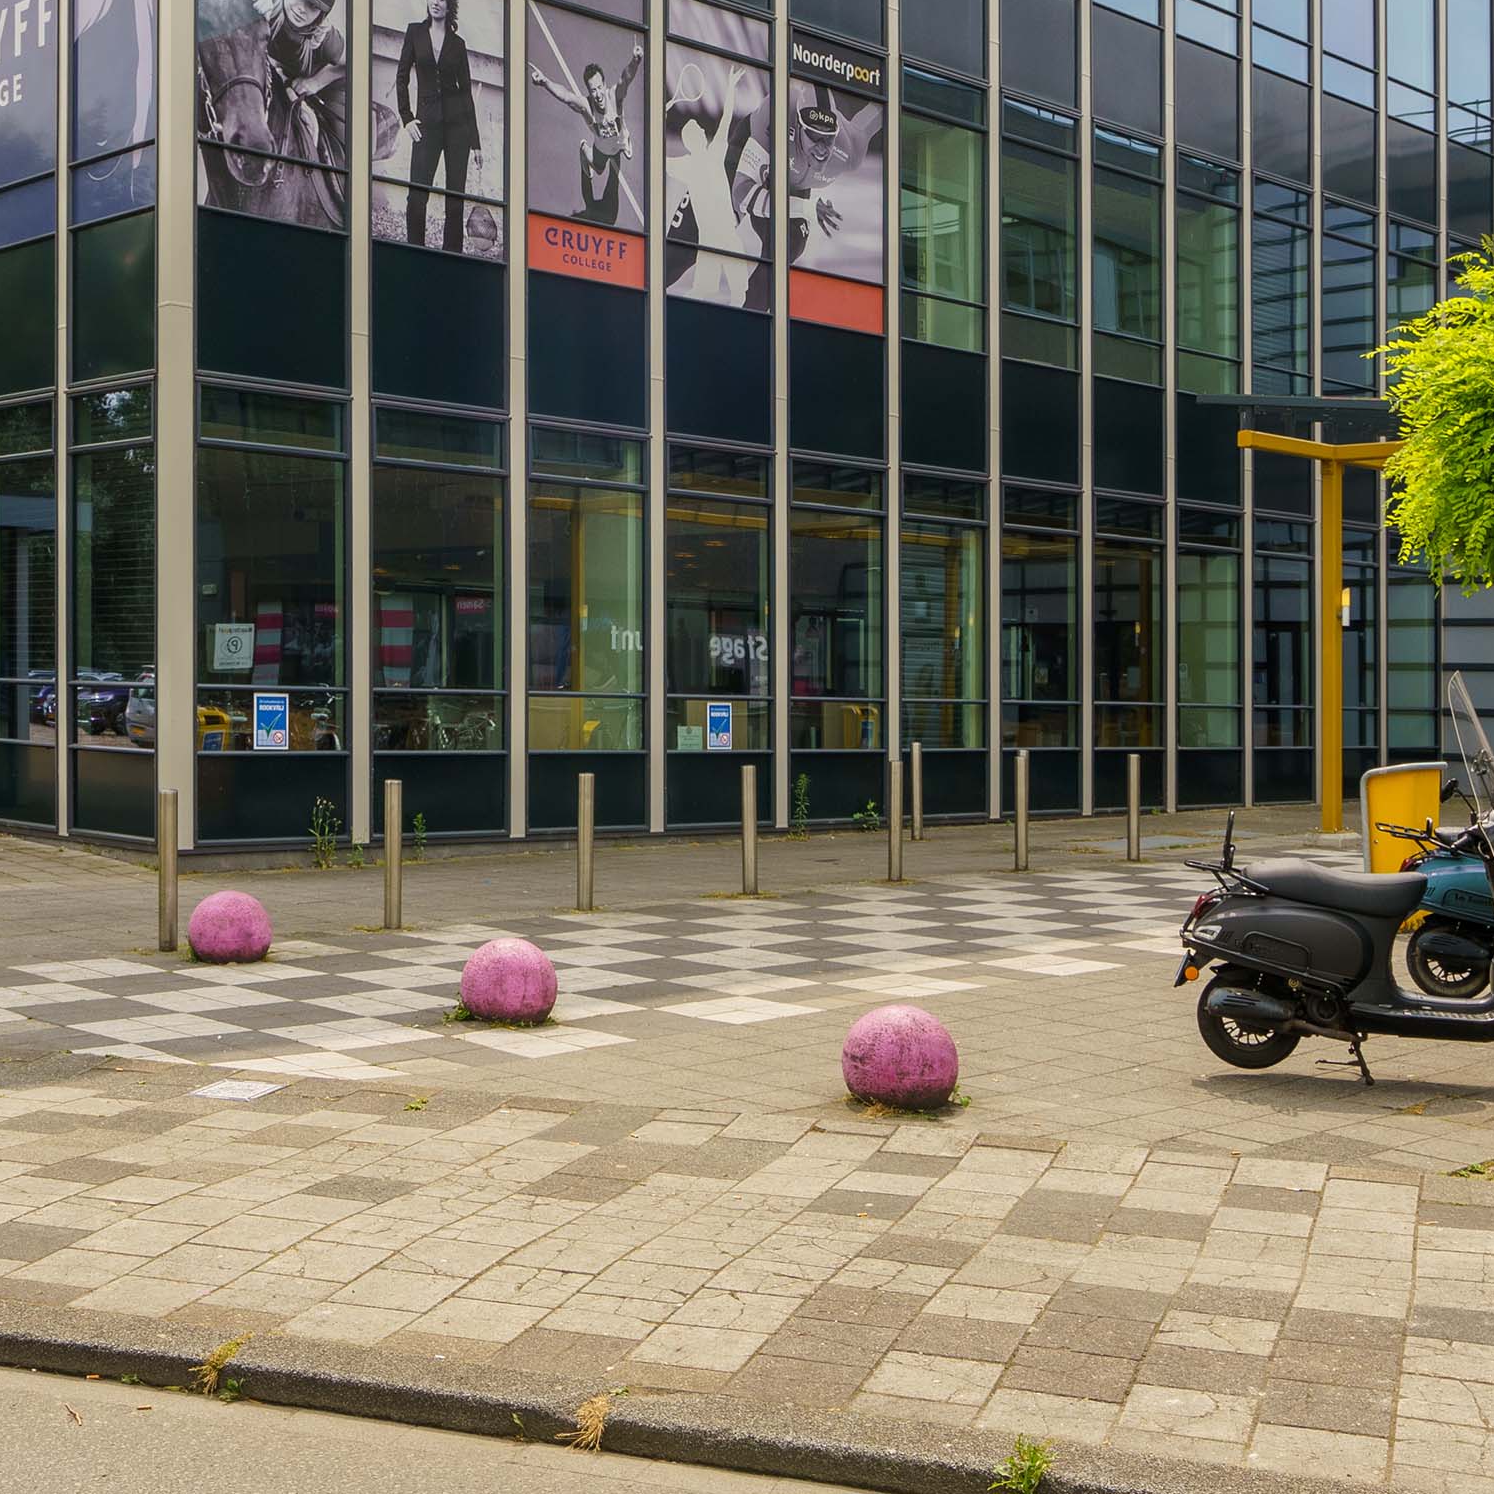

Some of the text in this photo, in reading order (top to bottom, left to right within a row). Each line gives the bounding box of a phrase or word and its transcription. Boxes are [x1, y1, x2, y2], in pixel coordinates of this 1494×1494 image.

[792, 42, 881, 87] Noorderpoort
[818, 111, 835, 124] kpn
[544, 225, 628, 261] CRUYFF
[561, 252, 613, 273] COLLEGE
